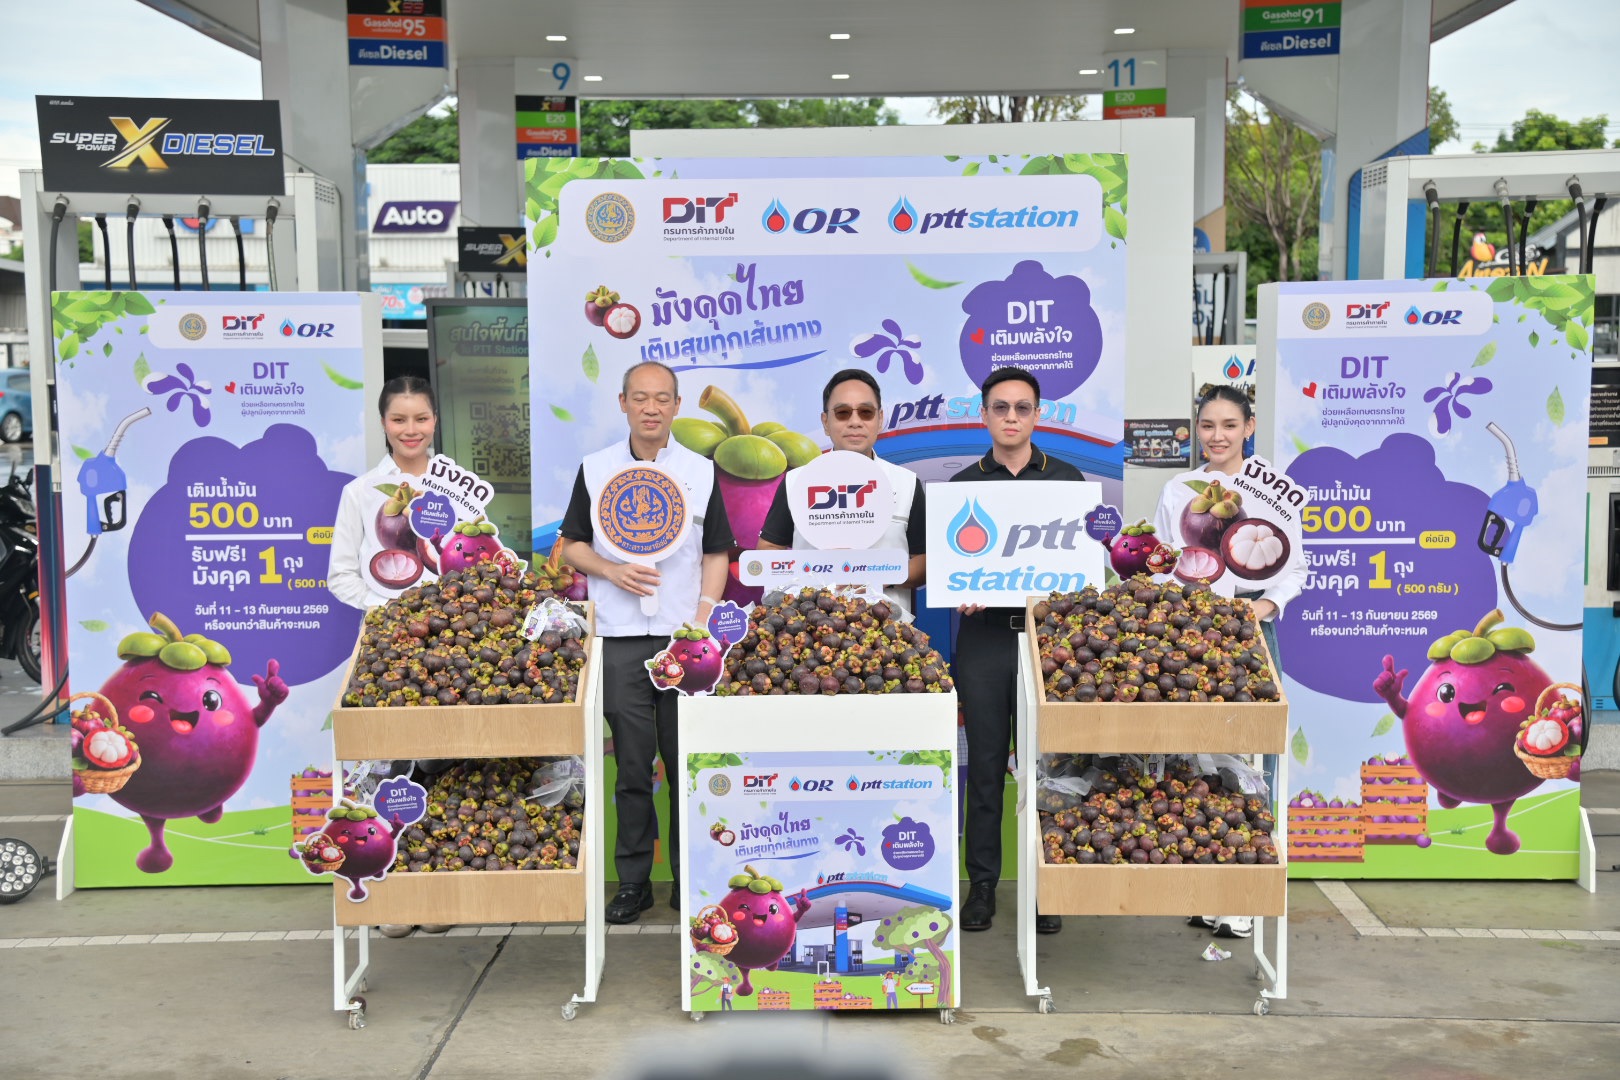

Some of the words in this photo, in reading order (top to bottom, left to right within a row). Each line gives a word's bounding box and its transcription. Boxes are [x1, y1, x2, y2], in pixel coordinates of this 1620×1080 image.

[1262, 9, 1301, 20] Gasohol
[1302, 8, 1324, 24] 91
[364, 18, 402, 28] Gasohol
[402, 18, 426, 36] 95
[1282, 33, 1331, 50] Diesel
[380, 45, 428, 60] Diesel
[552, 62, 570, 90] 9
[1108, 58, 1135, 87] 11
[1140, 106, 1156, 118] 95
[50, 132, 118, 145] SUPER
[162, 133, 275, 156] DIESEL
[552, 130, 567, 140] 95
[541, 146, 572, 157] Diesel
[382, 206, 444, 226] Auto
[792, 207, 860, 234] OR
[664, 226, 734, 235] กรมการค้าภายใน
[650, 262, 805, 331] มังคุดไทย
[1008, 300, 1054, 324] DIT
[1422, 310, 1462, 326] OR
[297, 322, 335, 338] OR
[990, 326, 1073, 346] เติมพลังใจ
[641, 320, 822, 364] เติมสุขทุกเส้นทาง
[992, 350, 1072, 362] ช่วยเหลือเกษตรกรไทย
[253, 362, 290, 380] DIT
[1340, 356, 1389, 379] DIT
[240, 382, 304, 395] เติมพลังใจ
[1322, 382, 1406, 400] เติมพลังใจ
[888, 393, 945, 429] ptt
[946, 392, 1077, 424] ston
[1322, 406, 1405, 416] ช่วยเหลือเกษตรกรไทย
[186, 476, 256, 498] เติมน้ำมัน
[430, 458, 489, 502] มังคุด
[1244, 460, 1304, 507] มังคุด
[422, 478, 480, 516] Mangosteen
[1308, 480, 1371, 501] ติมน้ำมัน
[428, 501, 444, 511] DIT
[1234, 478, 1292, 522] Mangosteen
[189, 502, 260, 529] 500
[263, 516, 293, 528] บาท
[808, 510, 874, 520] กรมการค้าภายใน
[1302, 506, 1372, 532] 500
[1376, 520, 1406, 532] บาท
[1002, 518, 1084, 558] ptt
[1425, 534, 1450, 543] ต่อบิล
[192, 544, 246, 562] รับฟรี!
[258, 546, 282, 584] 1
[283, 556, 304, 574] ถุง
[812, 564, 834, 573] OR
[1304, 548, 1356, 566] รับฟรี!
[1368, 550, 1392, 589] 1
[1394, 560, 1414, 578] ถุง
[192, 566, 250, 592] มังคุด
[294, 578, 316, 588] 500
[946, 565, 1086, 592] station
[1302, 570, 1360, 597] มังคุด
[1404, 584, 1426, 594] 500
[1428, 582, 1452, 594] กรัม
[195, 601, 216, 616] วันที่
[220, 606, 231, 615] 11
[243, 605, 256, 614] 13
[258, 604, 300, 614] กันยายน
[303, 604, 329, 614] 2569
[721, 611, 734, 620] DIT
[1302, 606, 1324, 620] วันที่
[1326, 610, 1338, 620] 11
[1350, 610, 1363, 620] 13
[1365, 609, 1408, 620] กันยายน
[1411, 610, 1438, 620] 2569
[204, 618, 320, 631] หรือจนกว่าสินค้าจะหมด
[1310, 624, 1428, 636] หรือจนกว่าสินค้าจะหมด
[390, 788, 407, 797] DIT
[803, 779, 834, 792] OR
[740, 811, 811, 842] มังคุดไทย
[892, 841, 924, 849] เติมพลังใจ
[898, 831, 917, 841] DIT
[735, 836, 819, 857] เติมสุขทุกเส้นทาง
[826, 871, 845, 883] ptt
